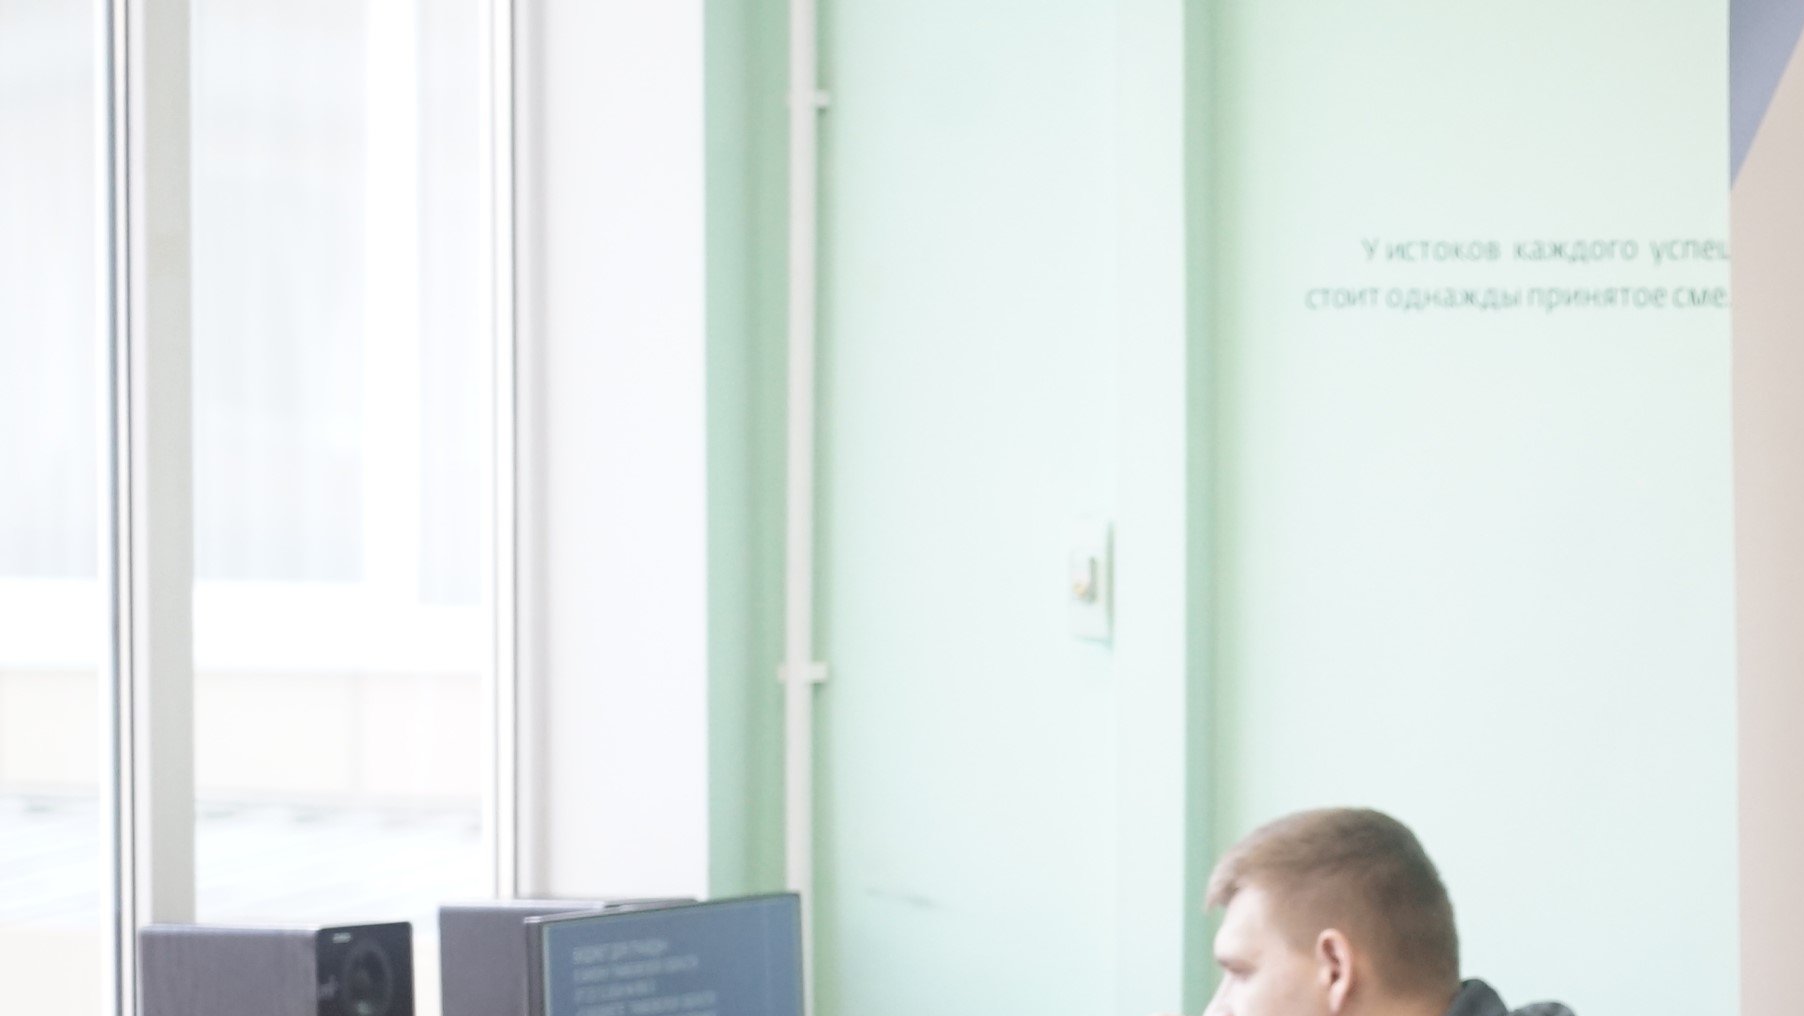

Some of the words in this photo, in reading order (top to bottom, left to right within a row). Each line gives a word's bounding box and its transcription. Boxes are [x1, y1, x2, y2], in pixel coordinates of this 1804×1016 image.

[1386, 239, 1501, 262] истоков
[1513, 238, 1639, 265] каждого
[1304, 286, 1379, 310] стоит
[1385, 286, 1522, 313] однажды
[1527, 286, 1668, 315] принятое
